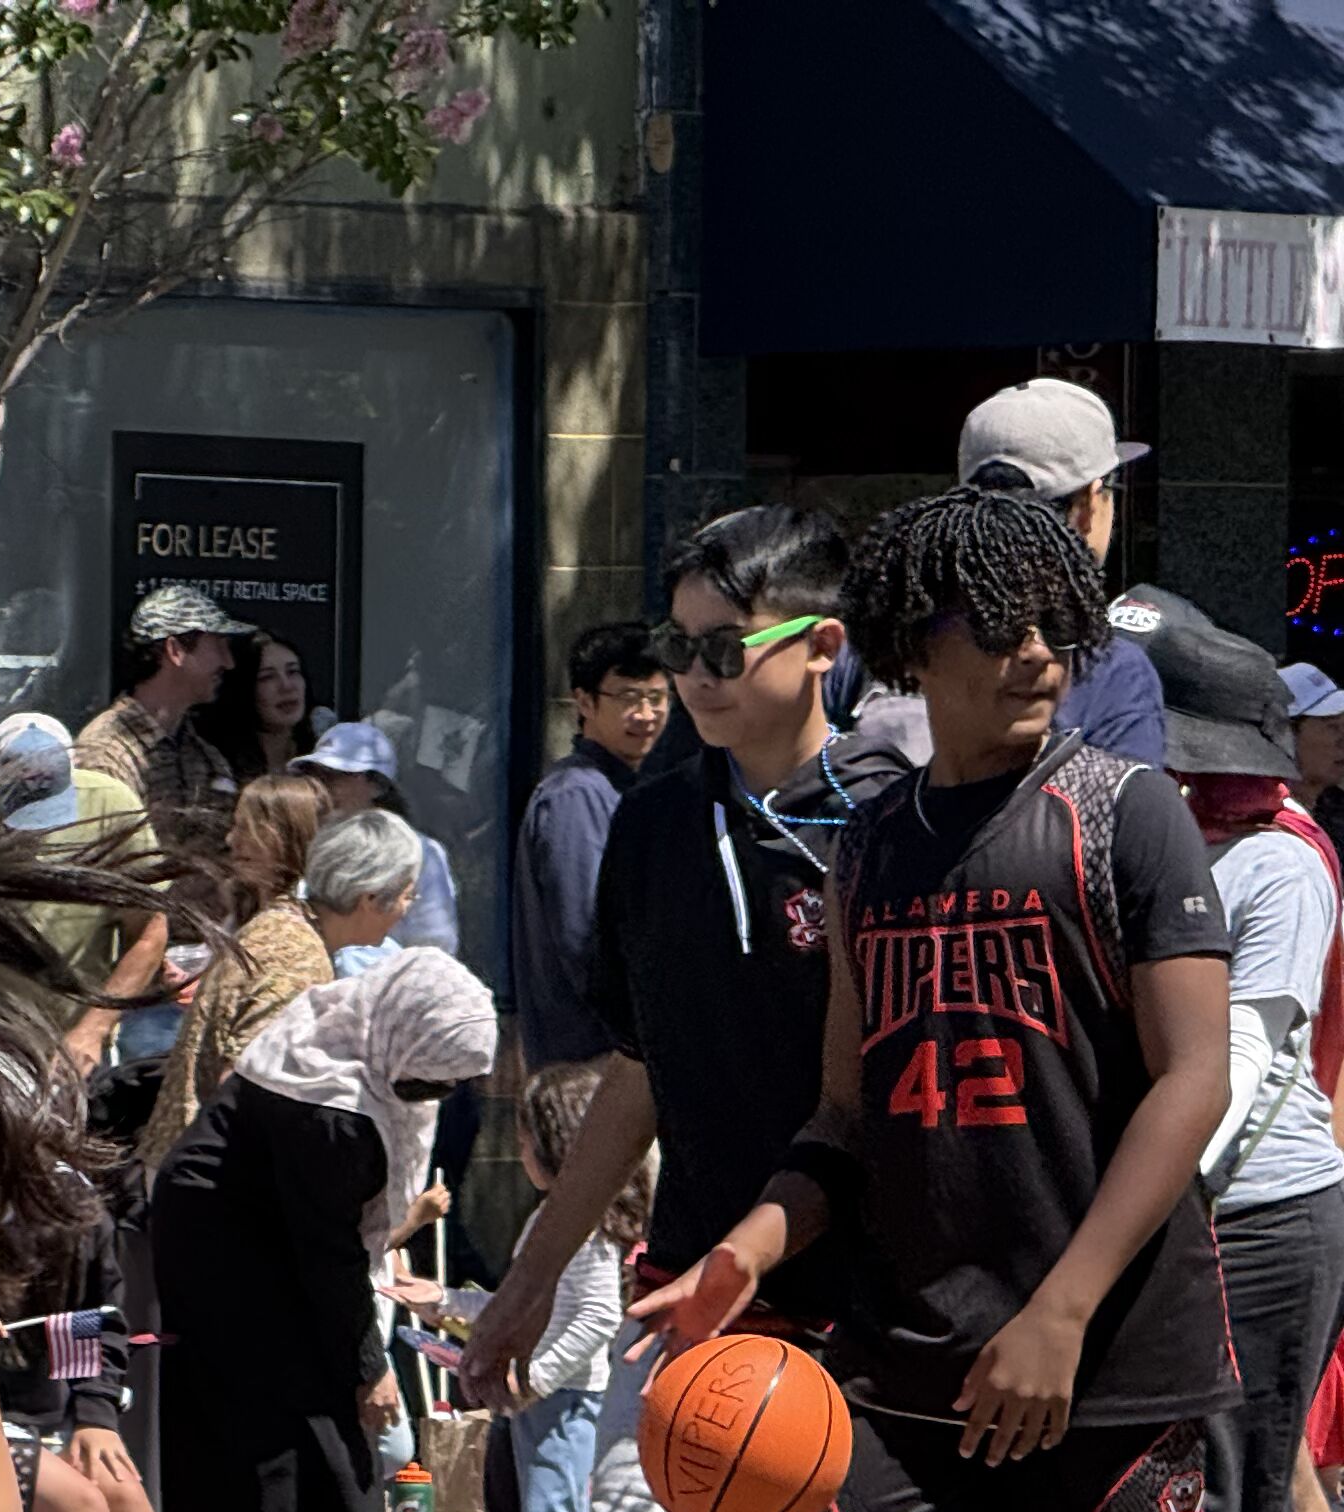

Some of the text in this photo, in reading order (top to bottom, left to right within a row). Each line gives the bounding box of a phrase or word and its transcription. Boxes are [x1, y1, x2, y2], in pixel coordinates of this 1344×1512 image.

[137, 522, 279, 560] FOR LEASE
[213, 579, 231, 598] FT
[232, 581, 281, 600] RETAIL
[282, 582, 329, 602] SPACE
[857, 914, 1070, 1056] VIPERS
[888, 1038, 1028, 1128] 42
[677, 1361, 757, 1496] VIPERS
